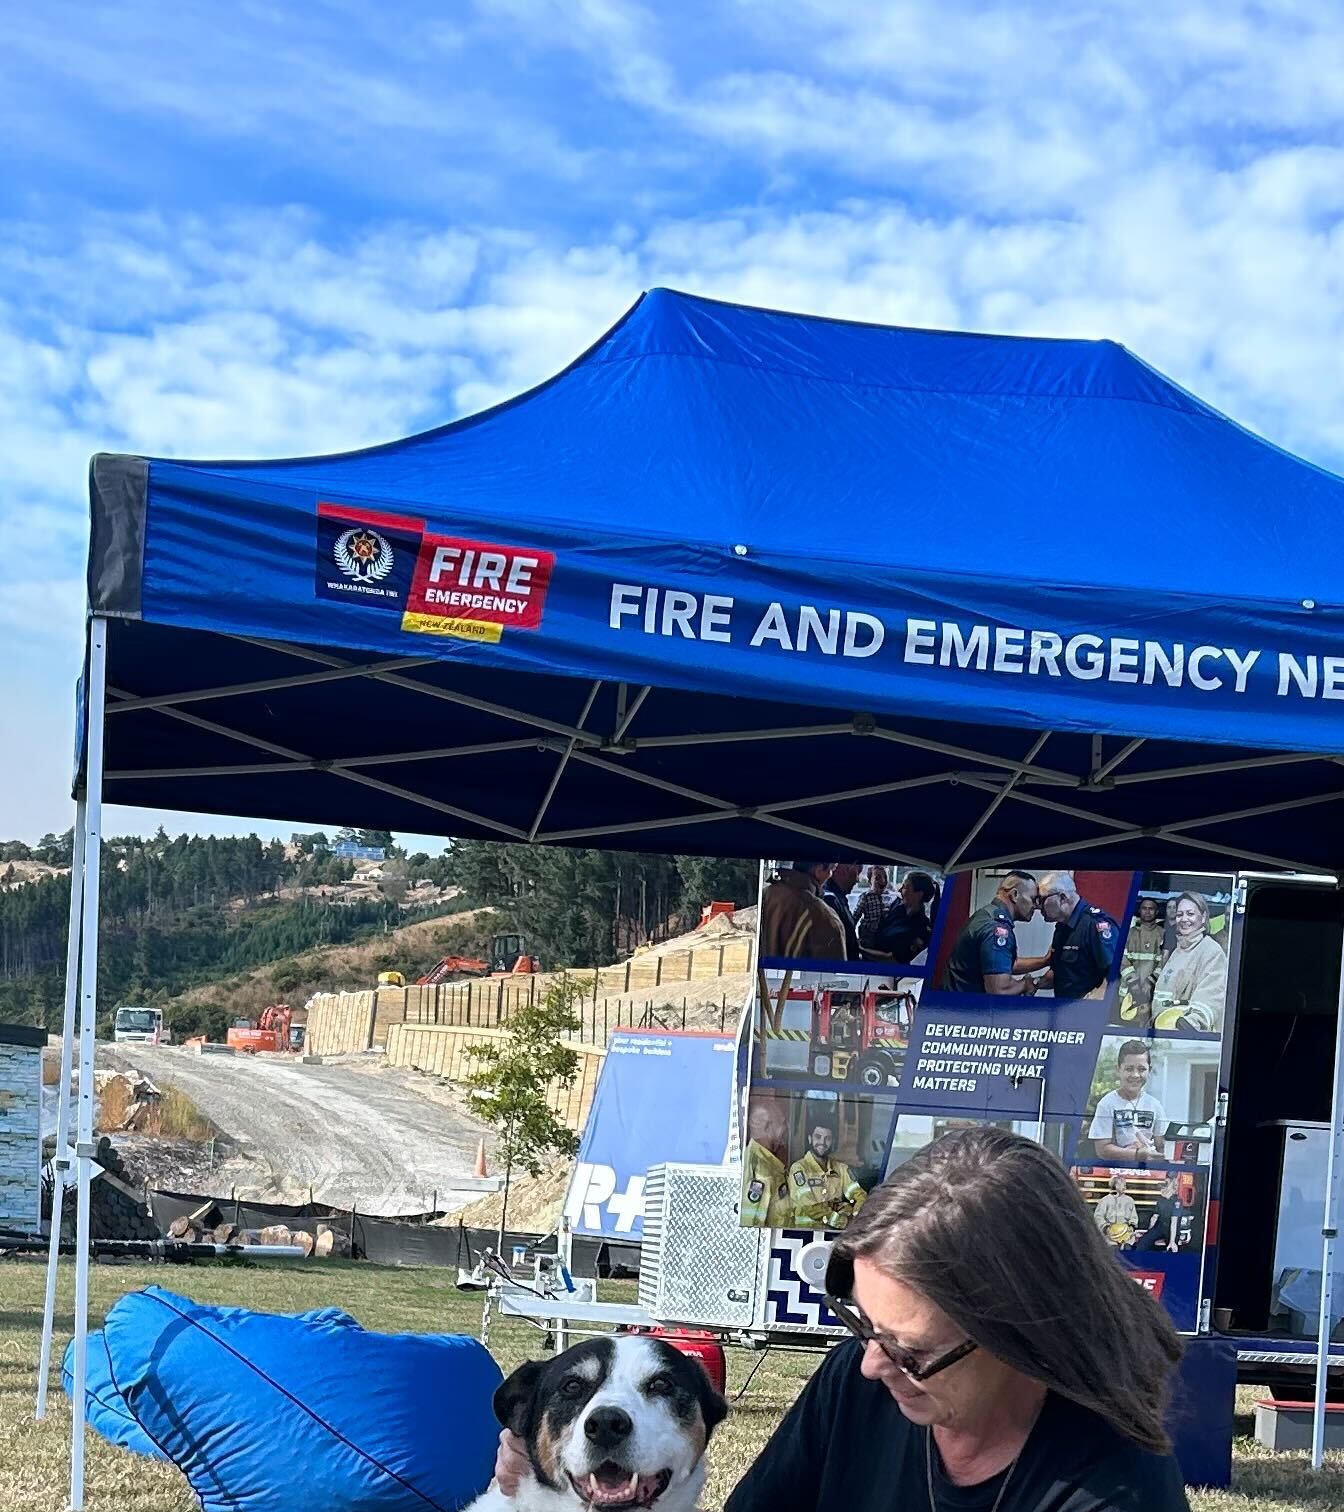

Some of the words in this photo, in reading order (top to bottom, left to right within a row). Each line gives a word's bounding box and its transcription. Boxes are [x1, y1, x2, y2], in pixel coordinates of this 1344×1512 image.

[429, 546, 539, 595] FIRE
[425, 588, 528, 614] EMERGENCY
[419, 619, 441, 630] NEW
[442, 621, 486, 636] ZEALAND
[609, 583, 734, 643] FIRE
[750, 602, 885, 658] AND
[904, 618, 1261, 693] EMERGENCY
[925, 1023, 1010, 1041] DEVELOPING
[1012, 1028, 1085, 1045] STRONGER
[921, 1041, 1016, 1059] COMMUNITIES
[1018, 1047, 1049, 1060] AND
[917, 1058, 1001, 1076] PROTECTING
[1004, 1063, 1044, 1078] WHAT
[912, 1076, 977, 1092] MATTERS
